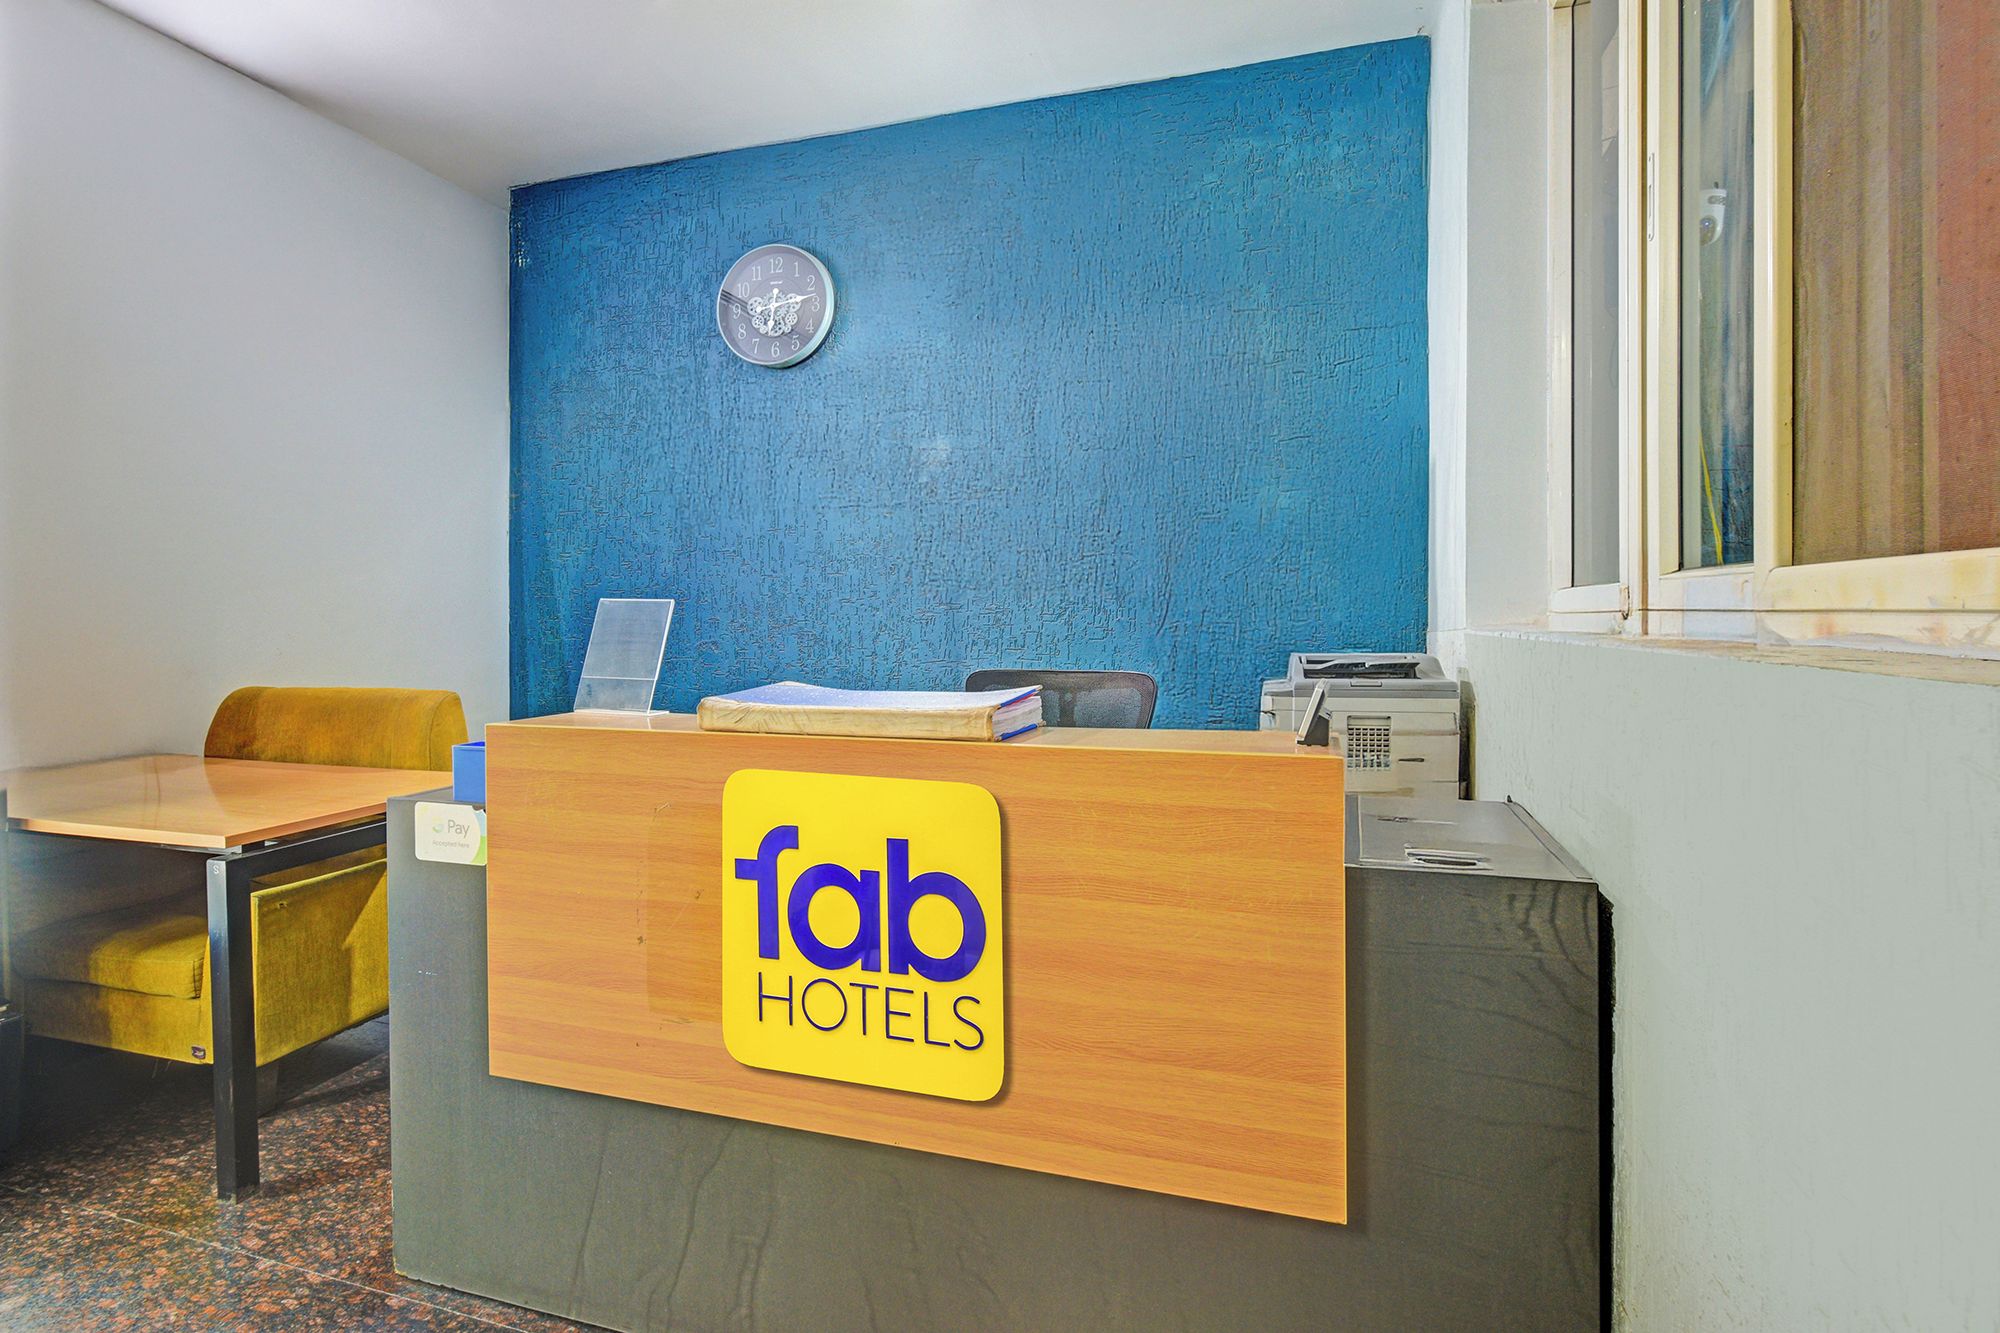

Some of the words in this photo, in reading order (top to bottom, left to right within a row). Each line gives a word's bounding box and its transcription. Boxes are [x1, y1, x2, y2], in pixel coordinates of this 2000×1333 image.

[752, 265, 762, 281] 11
[769, 257, 784, 274] 12
[794, 261, 800, 277] 1
[737, 282, 750, 298] 10
[807, 275, 815, 291] 2
[732, 303, 741, 319] 9
[811, 295, 820, 311] 3
[738, 323, 746, 339] 8
[805, 318, 814, 334] 4
[752, 338, 759, 354] 7
[771, 342, 780, 357] 6
[791, 335, 800, 351] 5
[447, 818, 470, 839] Pay
[734, 825, 987, 983] fab
[758, 972, 985, 1051] HOTELS
